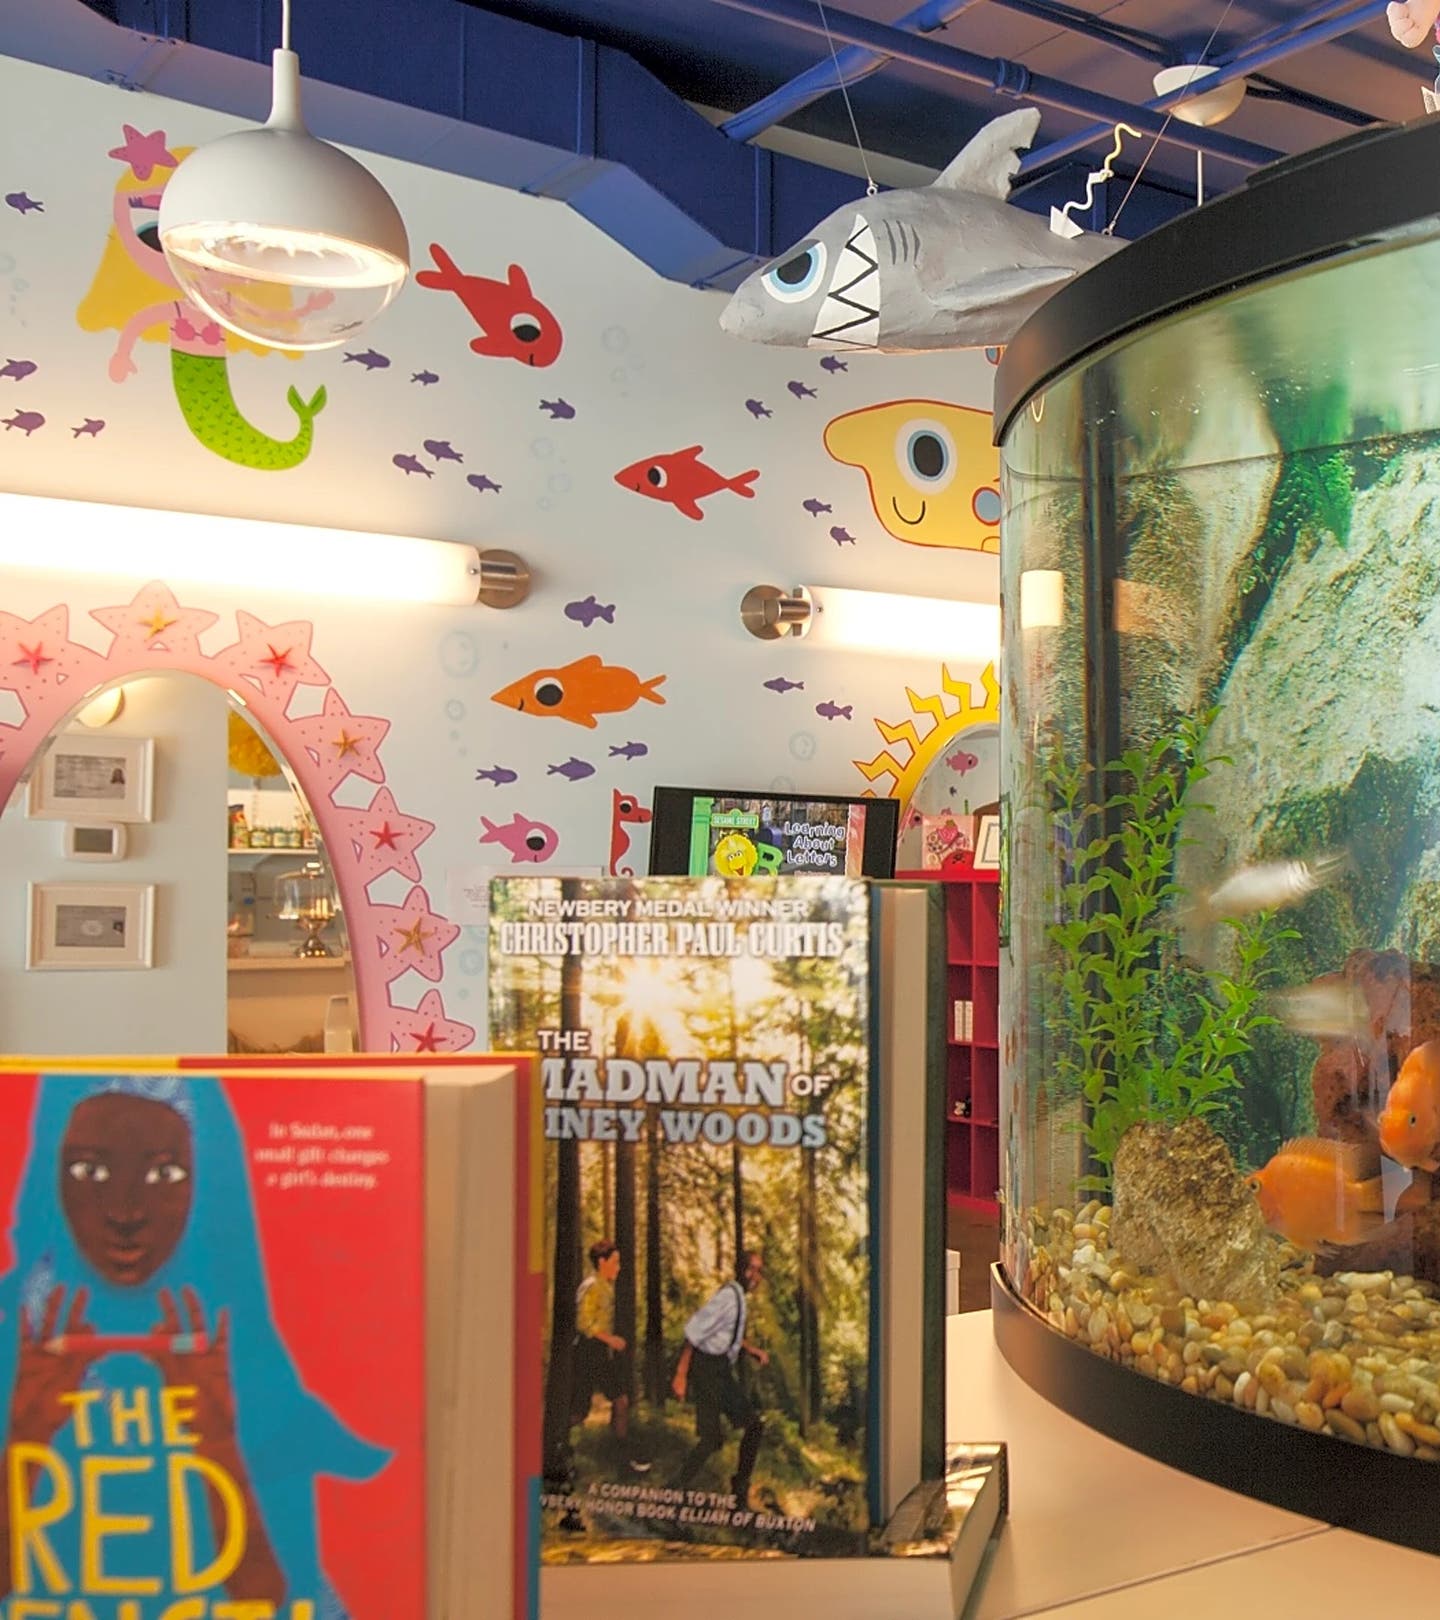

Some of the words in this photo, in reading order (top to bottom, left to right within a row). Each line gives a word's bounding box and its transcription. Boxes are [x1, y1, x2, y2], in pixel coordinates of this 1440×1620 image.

[784, 821, 846, 841] Learning
[793, 835, 835, 850] About
[787, 850, 838, 867] Letters
[528, 900, 632, 917] NEWBERY
[635, 900, 712, 917] MEDAL
[715, 900, 809, 918] WINNER
[500, 922, 669, 956] CHRISTOPHER
[677, 922, 741, 957] PAUL
[750, 922, 843, 957] CURTIS
[538, 1030, 590, 1051] THE
[791, 1074, 833, 1096] OF
[544, 1107, 646, 1142] INEY
[661, 1110, 828, 1148] WOODS
[254, 1147, 295, 1163] small
[296, 1147, 325, 1167] gift
[328, 1147, 389, 1167] changes
[58, 1385, 200, 1448] THE
[601, 1483, 684, 1504] COMPANION
[686, 1490, 707, 1507] TO
[708, 1492, 738, 1510] THE
[8, 1441, 248, 1596] RED
[636, 1502, 676, 1520] BOOK
[679, 1507, 731, 1526] ELIJAH
[732, 1511, 754, 1528] OF
[755, 1513, 817, 1533] BUXTON
